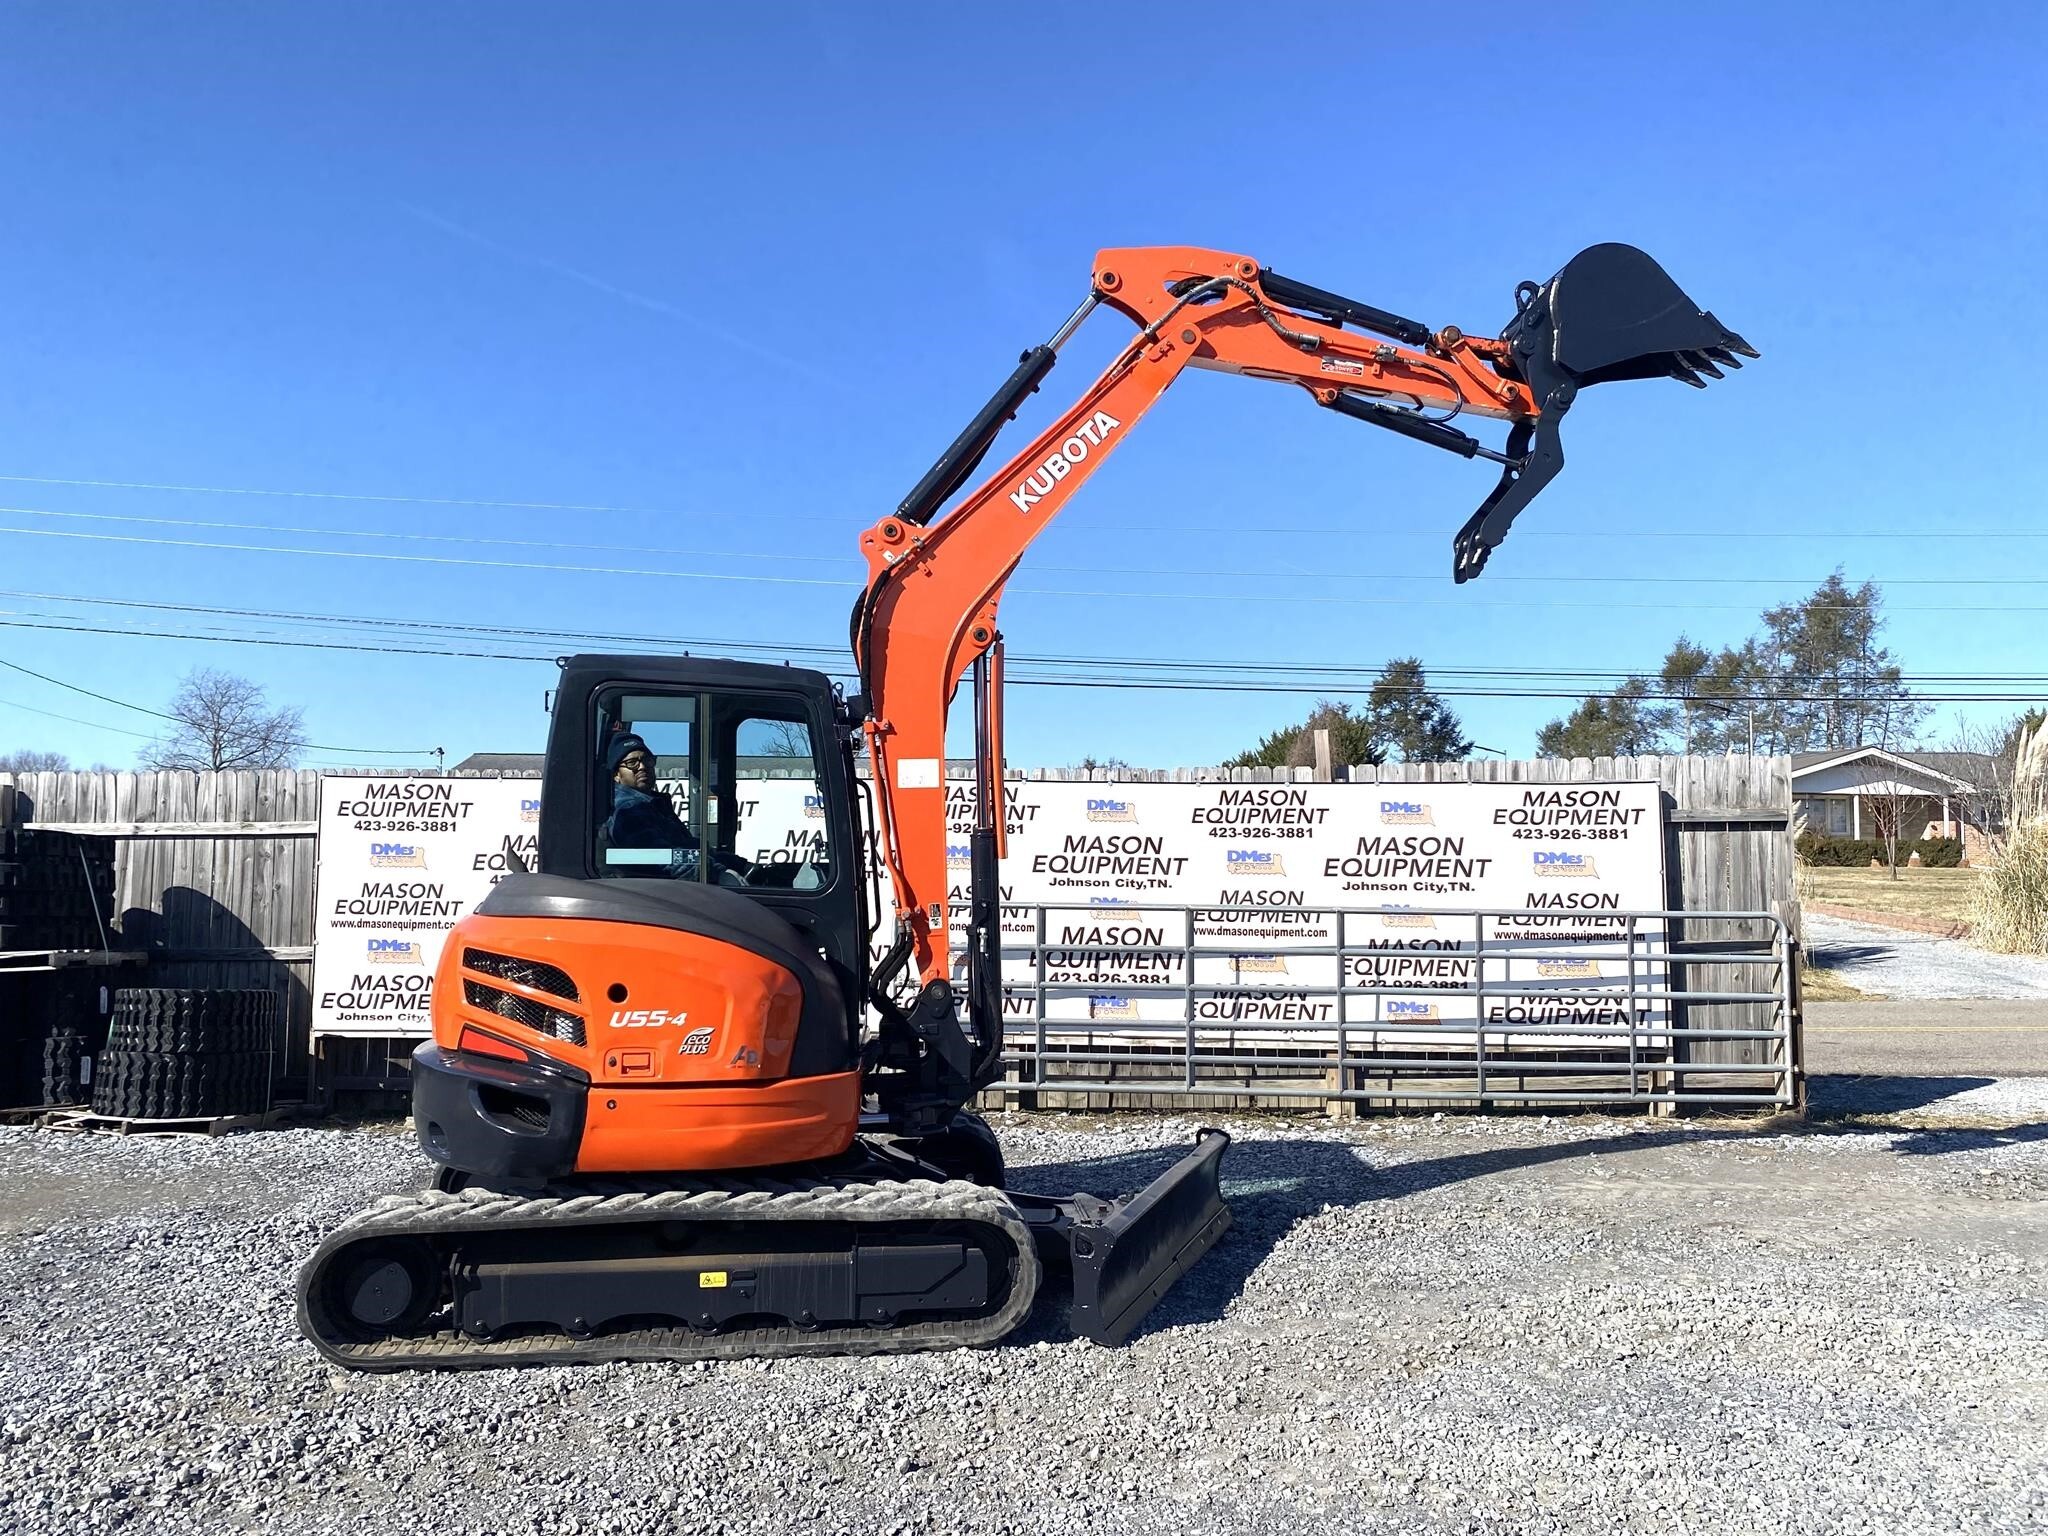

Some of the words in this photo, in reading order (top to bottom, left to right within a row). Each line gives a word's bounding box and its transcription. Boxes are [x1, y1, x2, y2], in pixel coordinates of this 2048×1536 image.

[1008, 409, 1121, 515] KUBOTA
[364, 783, 452, 800] MASON
[1218, 789, 1307, 806] MASON
[1522, 790, 1621, 807] MASON
[336, 800, 474, 818] EQUIPMENT
[1191, 807, 1330, 825] EQUIPMENT
[1493, 808, 1646, 826] EQUIPMENT
[353, 820, 457, 832] 423-926-3881
[1208, 827, 1314, 839] 423-926-3881
[1512, 828, 1628, 840] 423-926-3881
[1063, 834, 1164, 855] MASON
[1356, 836, 1465, 857] MASON
[1032, 854, 1189, 876] EQUIPMENT
[1323, 857, 1493, 878] EQUIPMENT
[360, 882, 444, 899] MASON
[1048, 877, 1111, 888] Johnson
[1341, 881, 1408, 892] Johnson
[1219, 890, 1305, 906] MASON
[1525, 892, 1620, 909] MASON
[334, 899, 464, 917] EQUIPMENT
[330, 918, 456, 931] www.dmasonequipment.co
[1061, 926, 1164, 946] MASON
[1494, 929, 1646, 943] www.dmasonequipment.cm
[320, 992, 430, 1010] EQUIPME
[336, 1012, 393, 1022] Johnson
[609, 1010, 688, 1028] U55-4
[690, 1034, 711, 1045] eco
[678, 1044, 709, 1055] PLUS
